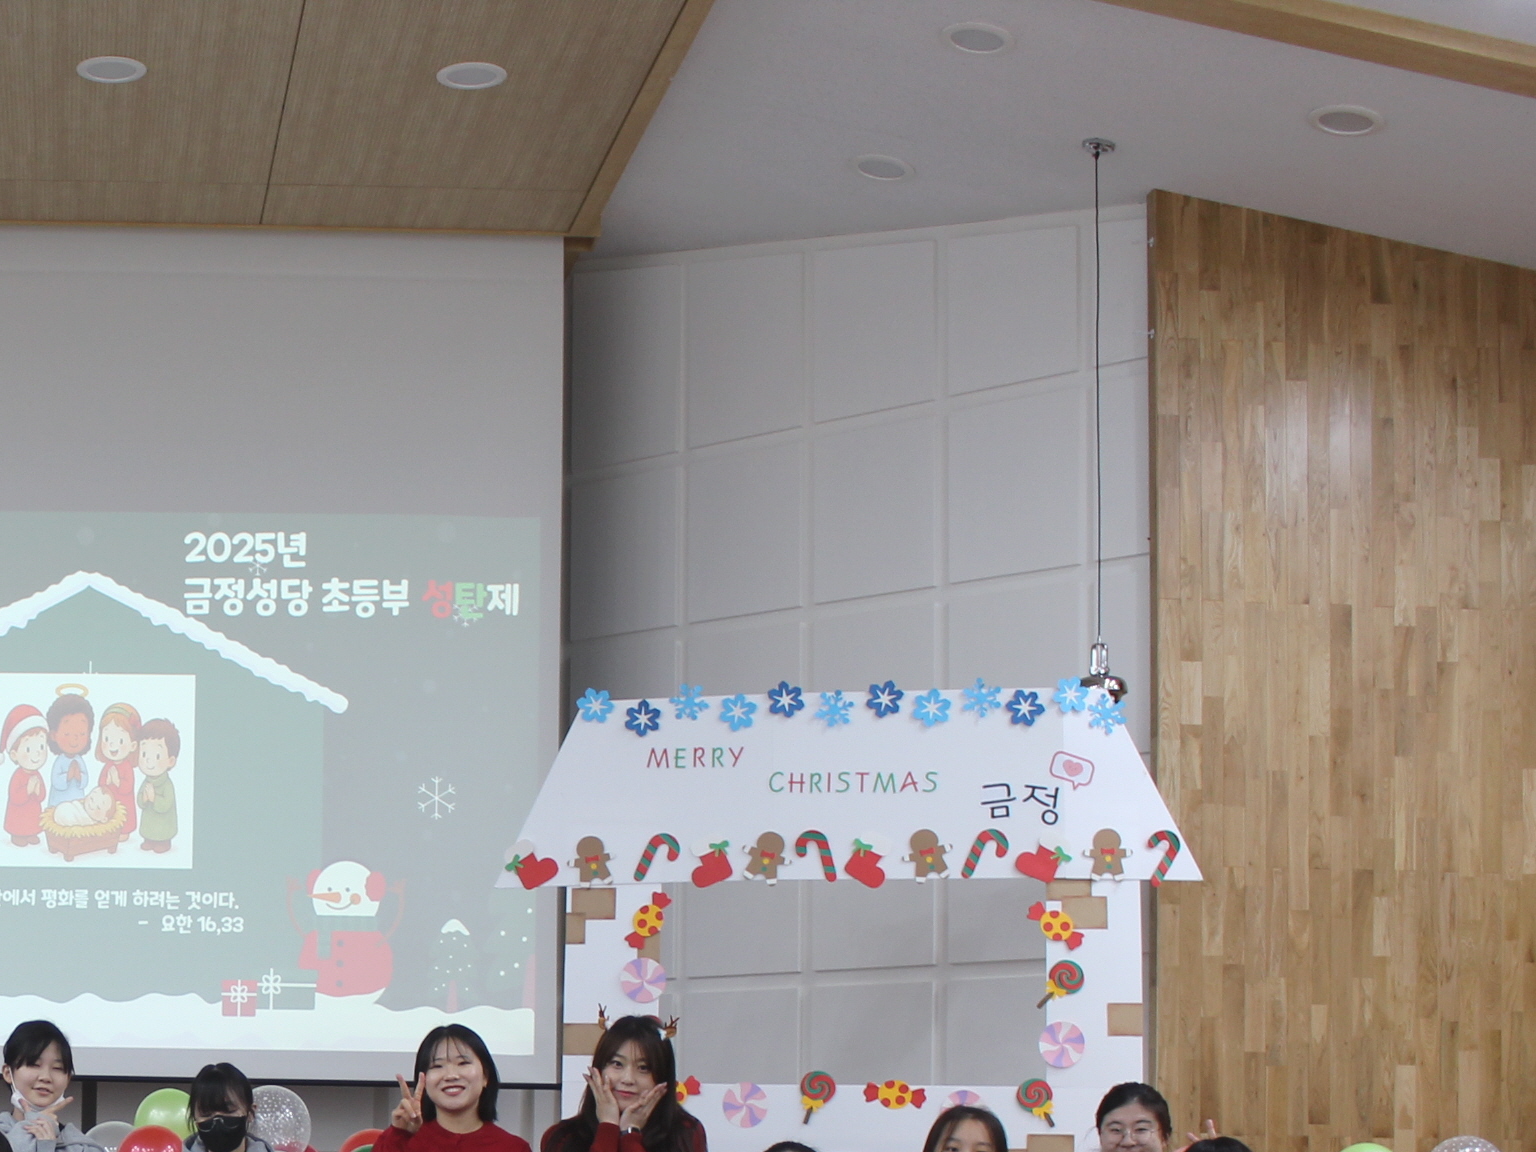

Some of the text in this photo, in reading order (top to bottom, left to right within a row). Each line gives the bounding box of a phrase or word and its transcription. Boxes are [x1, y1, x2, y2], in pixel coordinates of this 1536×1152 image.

[183, 532, 307, 568] 2025년
[183, 577, 520, 619] 금정성당 초등부 성탄제
[646, 746, 745, 769] MERRY
[768, 771, 938, 793] CHRISTMAS
[979, 782, 1061, 826] 금정
[41, 889, 89, 909] 평화를
[95, 889, 128, 909] 얻게
[132, 889, 180, 910] 하려는
[185, 891, 240, 911] 것이다.
[161, 915, 192, 934] 요한
[197, 916, 245, 936] 16,33
